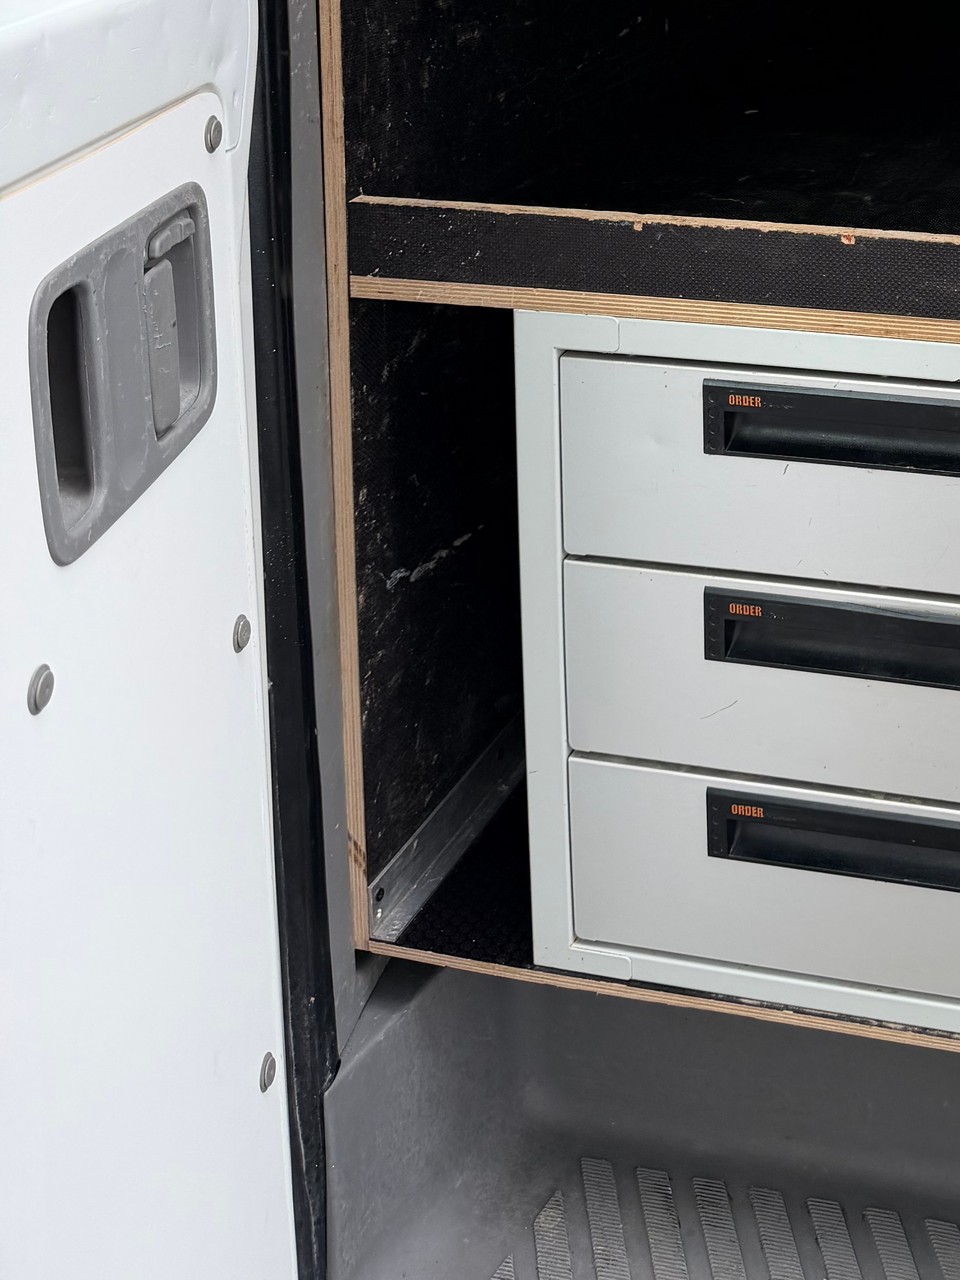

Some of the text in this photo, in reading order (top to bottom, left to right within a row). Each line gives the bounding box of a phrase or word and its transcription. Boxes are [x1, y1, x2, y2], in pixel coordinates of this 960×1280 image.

[728, 394, 762, 408] ORDER
[729, 602, 762, 617] ORDER
[731, 803, 764, 818] ORDER
